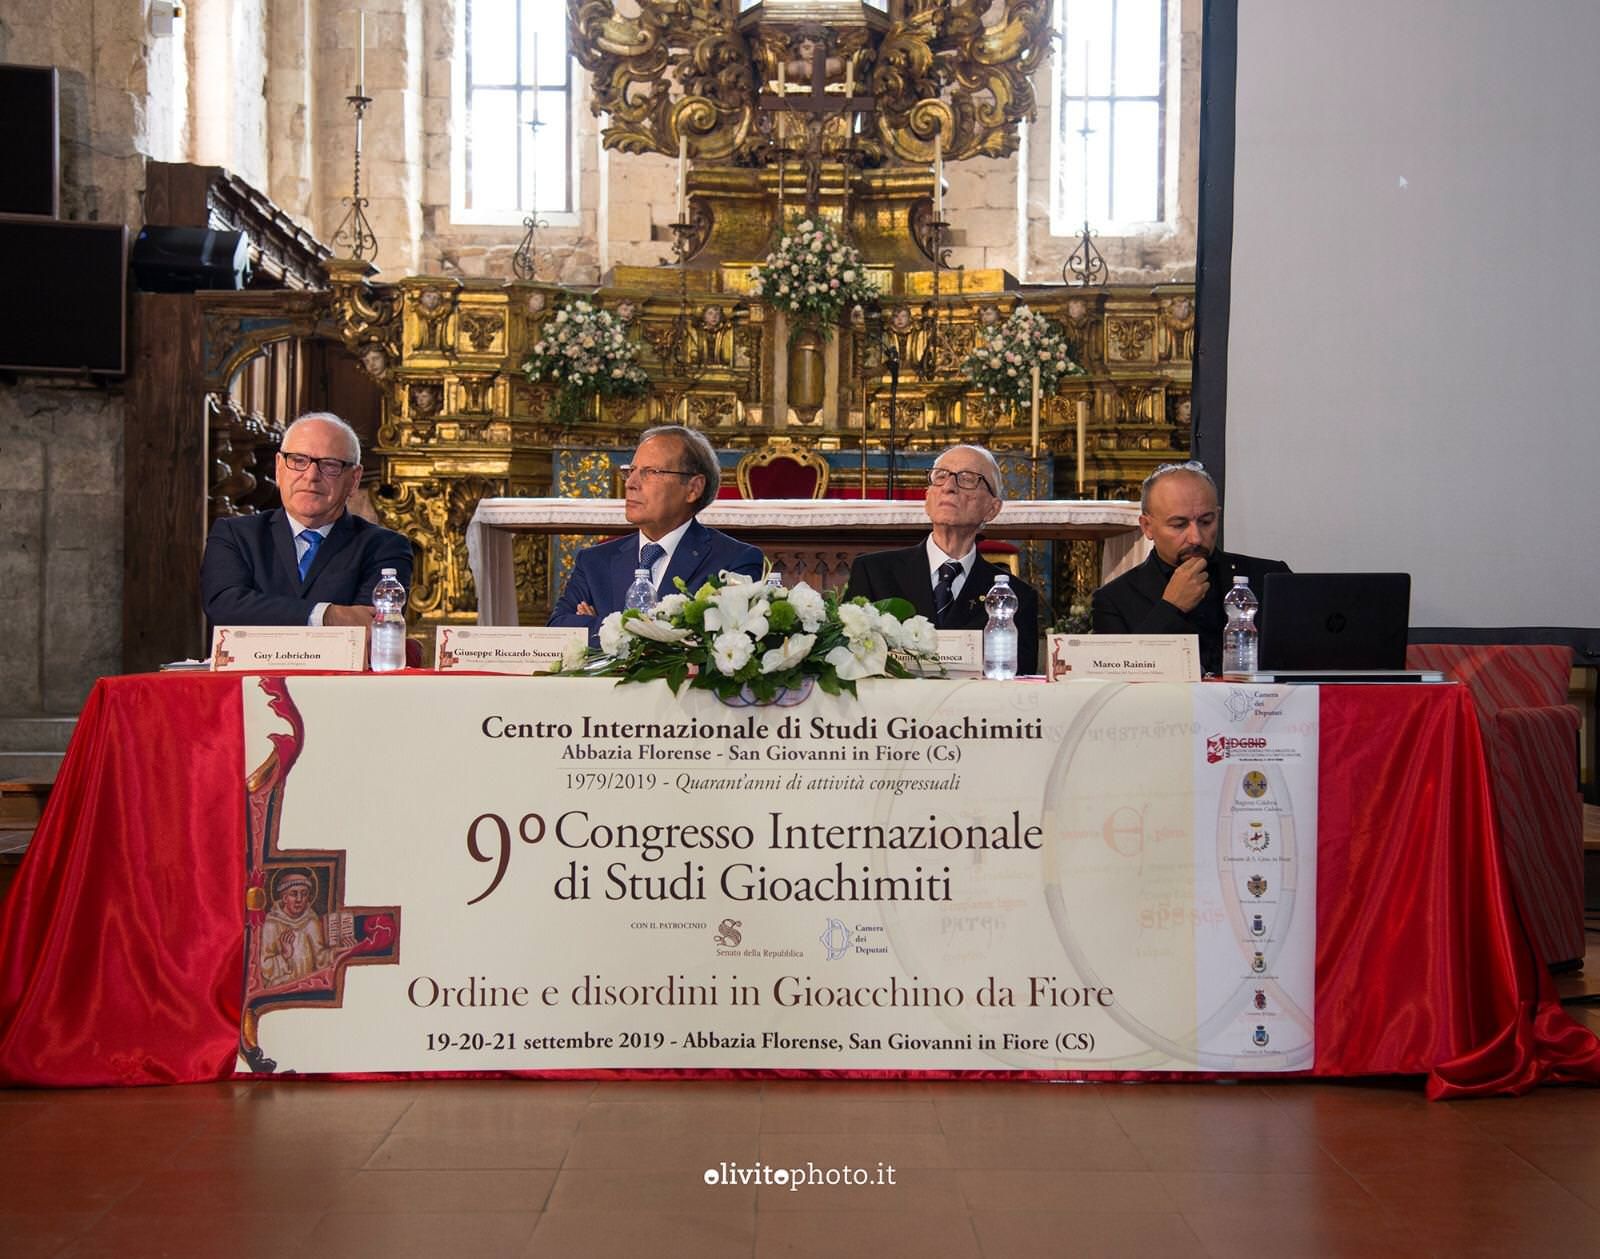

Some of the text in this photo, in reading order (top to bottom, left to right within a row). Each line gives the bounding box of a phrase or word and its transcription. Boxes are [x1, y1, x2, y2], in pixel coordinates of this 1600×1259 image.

[253, 651, 321, 662] Guy Lobrichon
[454, 648, 493, 659] Giuseppe
[495, 648, 531, 657] Riccardo
[1093, 660, 1156, 669] Marco Rainini
[482, 715, 573, 739] Centro
[581, 716, 769, 739] Internazionale
[776, 716, 803, 740] di
[809, 717, 878, 740] Studi
[886, 716, 1043, 740] Gioachimiti
[561, 744, 633, 760] Abbazia
[638, 744, 712, 761] Florense
[728, 745, 760, 761] San
[766, 745, 847, 761] Giovanni
[852, 745, 870, 761] in
[875, 745, 921, 761] Fiore
[926, 745, 962, 763] (Cs)
[566, 773, 657, 790] 1979/2019
[785, 773, 802, 790] di
[806, 773, 865, 791] attività
[869, 774, 961, 795] congressuali
[555, 811, 754, 861] Congresso
[768, 810, 1043, 849] Internazionale
[554, 861, 952, 901] di Studi Gioachimiti
[855, 924, 884, 932] Camera
[855, 946, 888, 955] Deputati
[407, 975, 1114, 1008] Ordine e disordini in Gioacchino da Fiore
[425, 1032, 518, 1051] 19-20-21
[523, 1032, 613, 1049] settembre
[619, 1033, 664, 1049] 2019
[683, 1032, 756, 1049] Abbazia
[761, 1032, 843, 1052] Florense,
[848, 1033, 882, 1049] San
[888, 1033, 972, 1050] Giovanni
[978, 1034, 997, 1050] in
[1002, 1034, 1049, 1050] Fiore
[1054, 1033, 1096, 1053] (CS)
